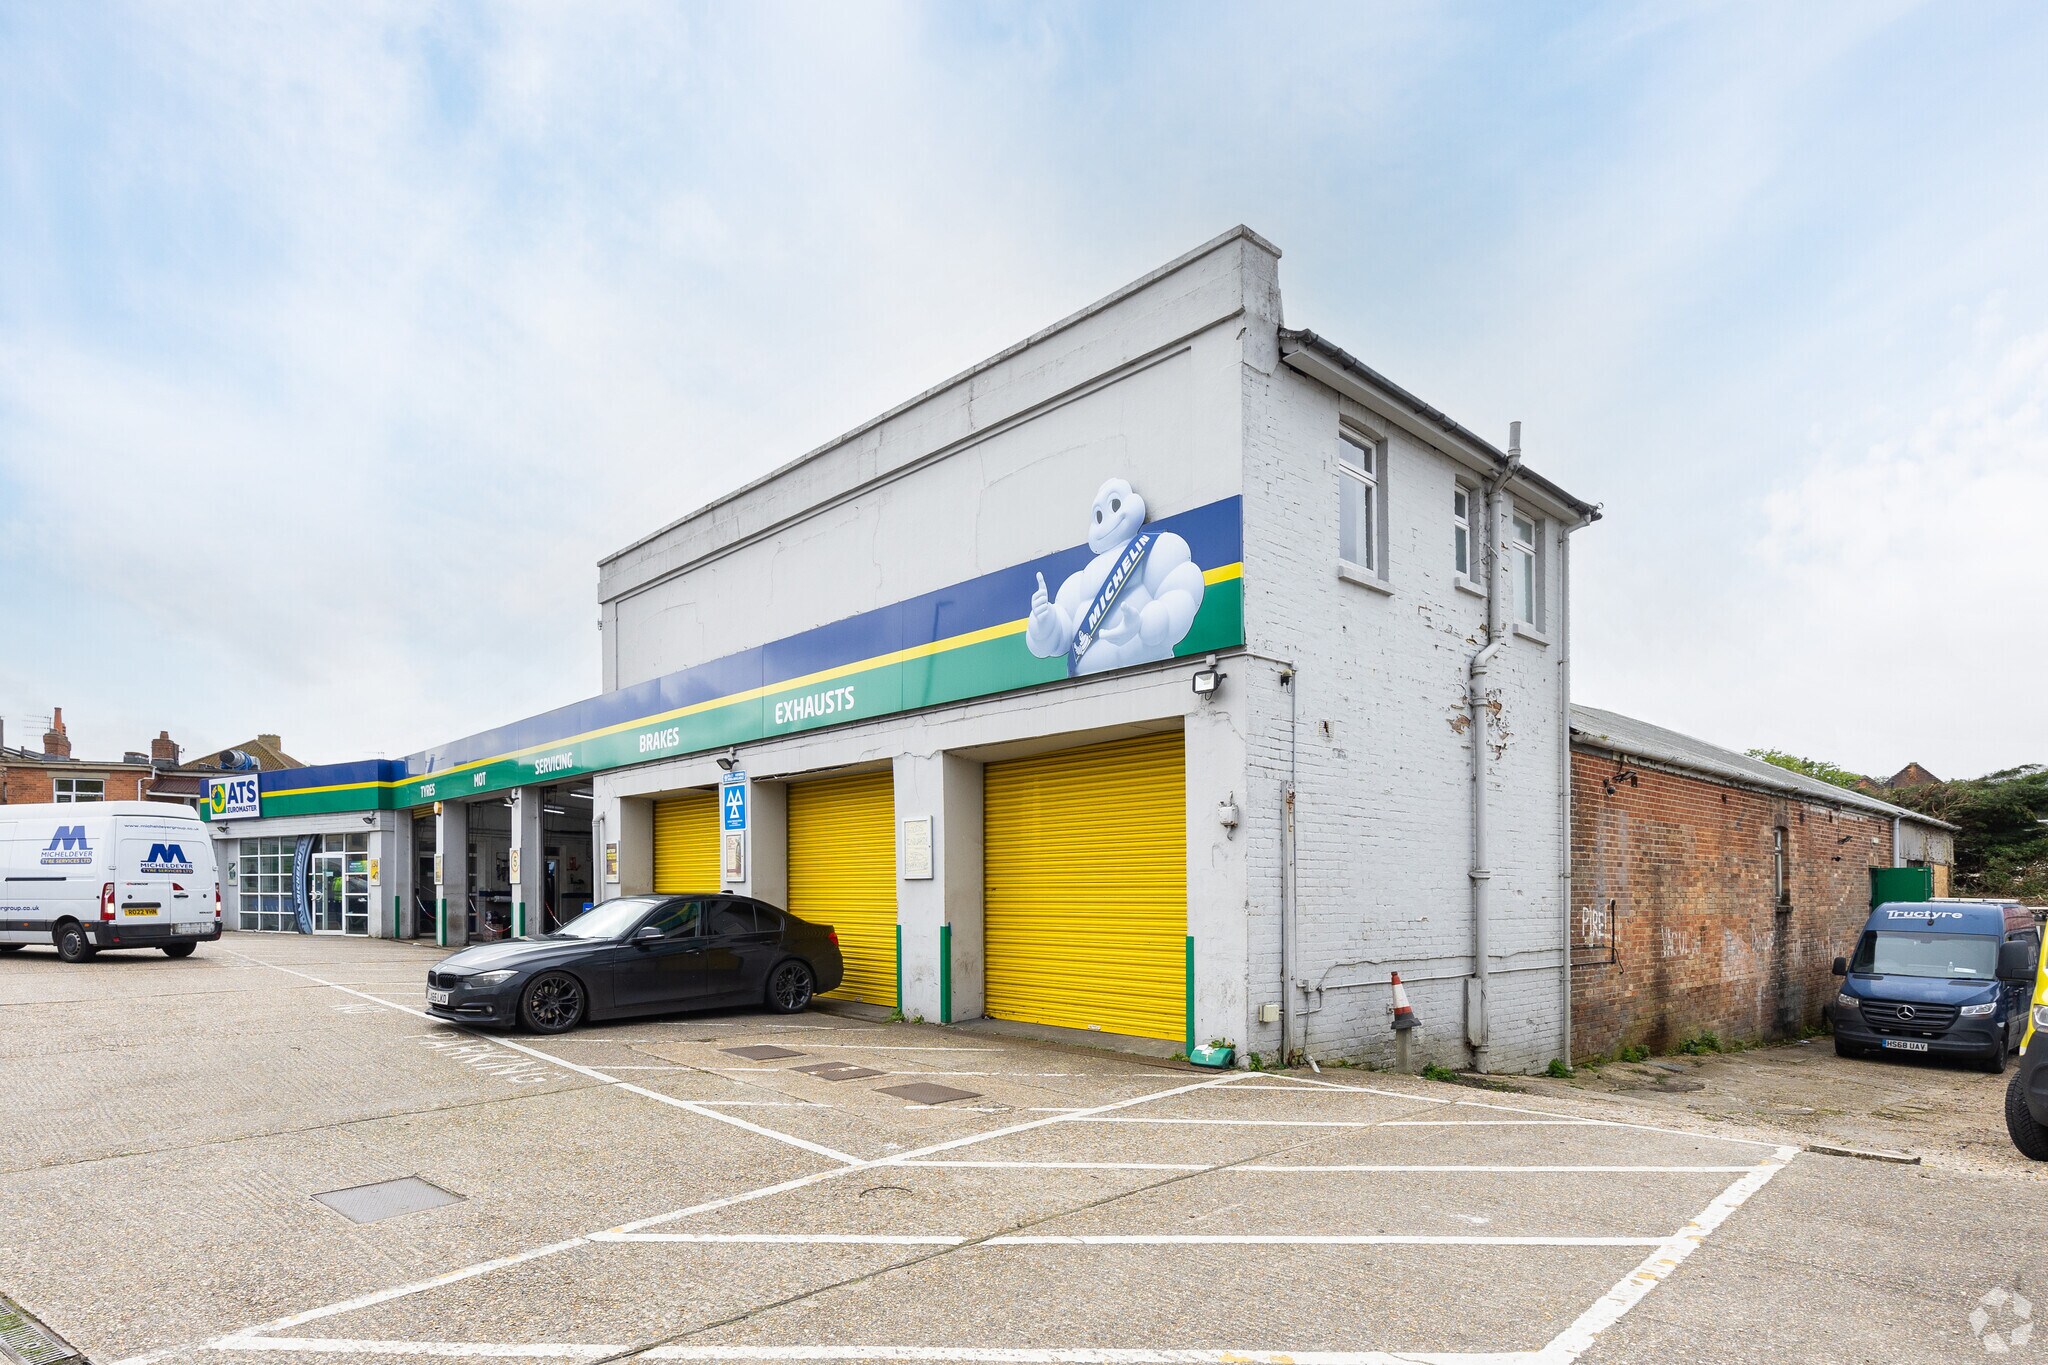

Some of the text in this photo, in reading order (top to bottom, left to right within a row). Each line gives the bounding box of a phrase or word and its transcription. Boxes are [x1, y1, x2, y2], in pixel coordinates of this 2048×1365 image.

[1088, 535, 1150, 629] MICHELIN
[775, 685, 855, 725] EXHAUSTS
[639, 726, 680, 753] BRAKES
[534, 751, 573, 775] SERVICING
[420, 783, 436, 798] TYRES
[473, 771, 487, 787] MOT
[227, 780, 257, 804] ATS
[227, 805, 257, 813] EUROMASTER
[295, 851, 303, 904] MICHELIN
[1886, 909, 1963, 920] Tructyre
[1887, 1040, 1926, 1050] HS68 UAV
[404, 1031, 550, 1084] PARKING
